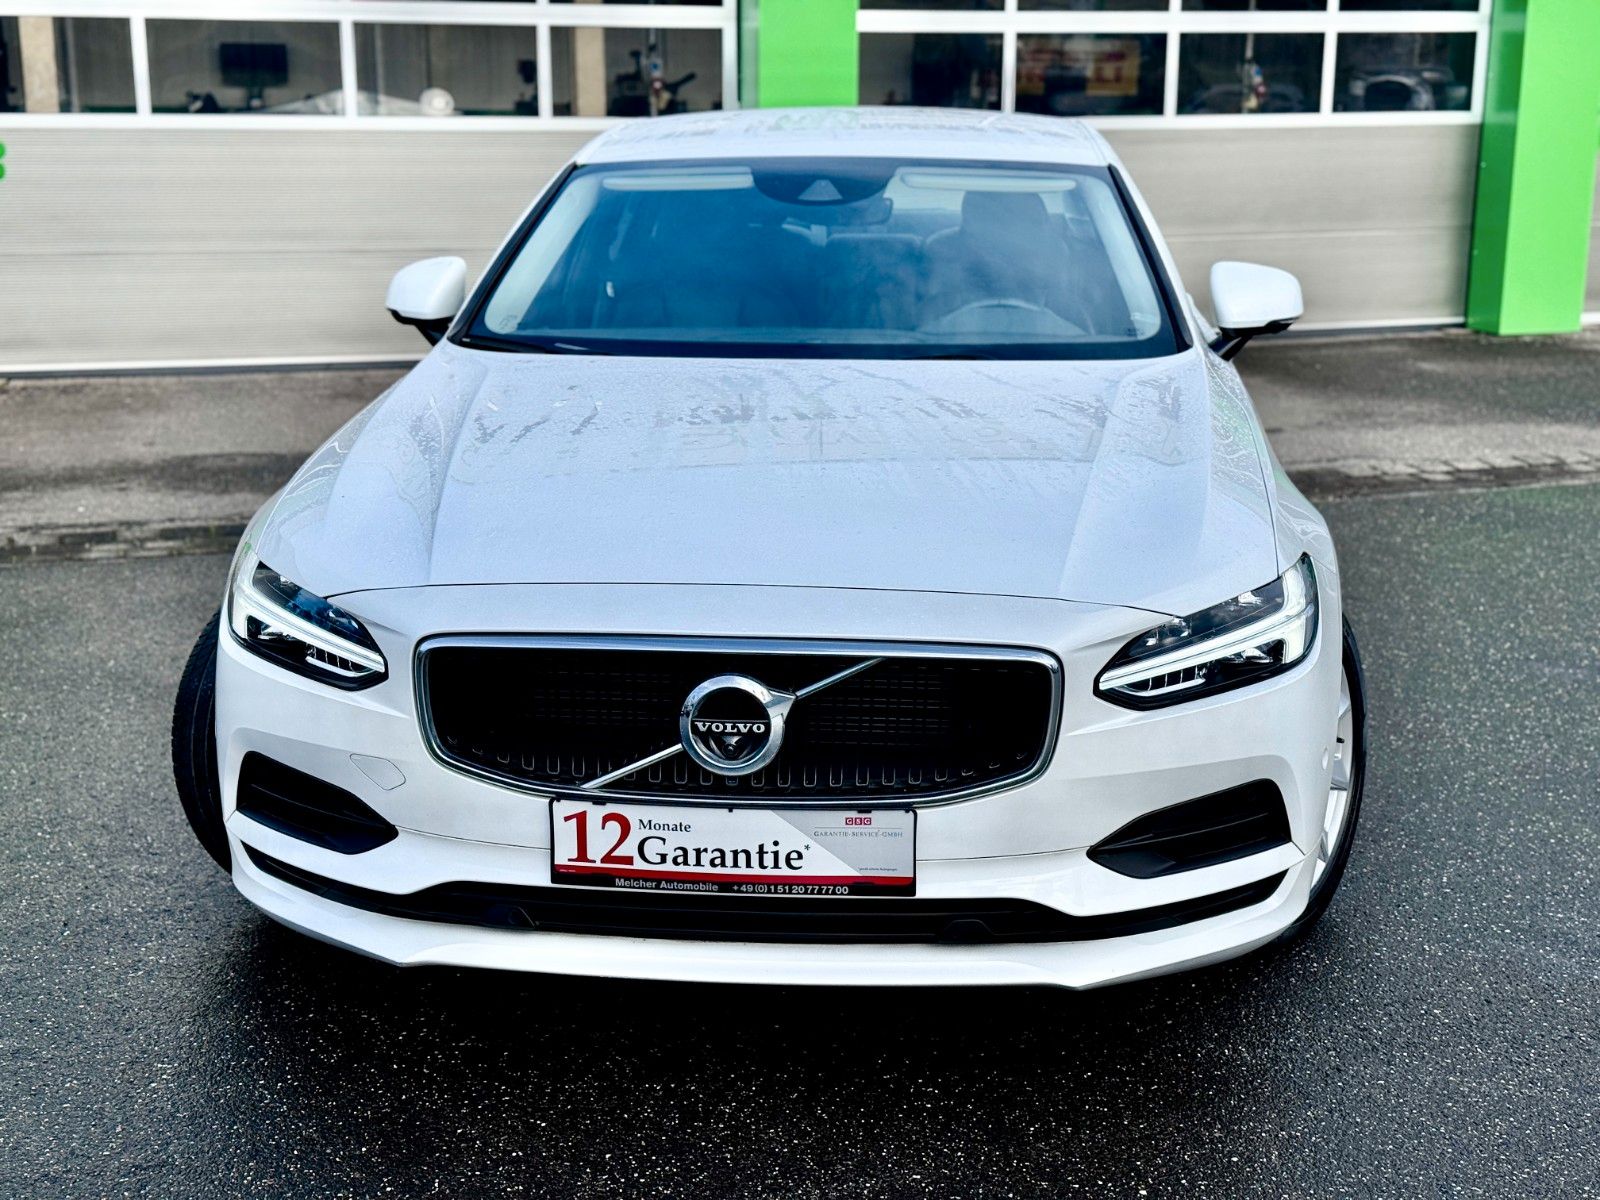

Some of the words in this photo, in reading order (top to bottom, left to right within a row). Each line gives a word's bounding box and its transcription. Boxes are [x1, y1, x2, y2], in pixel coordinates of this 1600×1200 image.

[694, 721, 765, 733] VOLVO
[638, 818, 692, 832] Monate
[563, 809, 634, 866] 12
[615, 878, 657, 889] Melcher
[660, 881, 719, 892] Automobile
